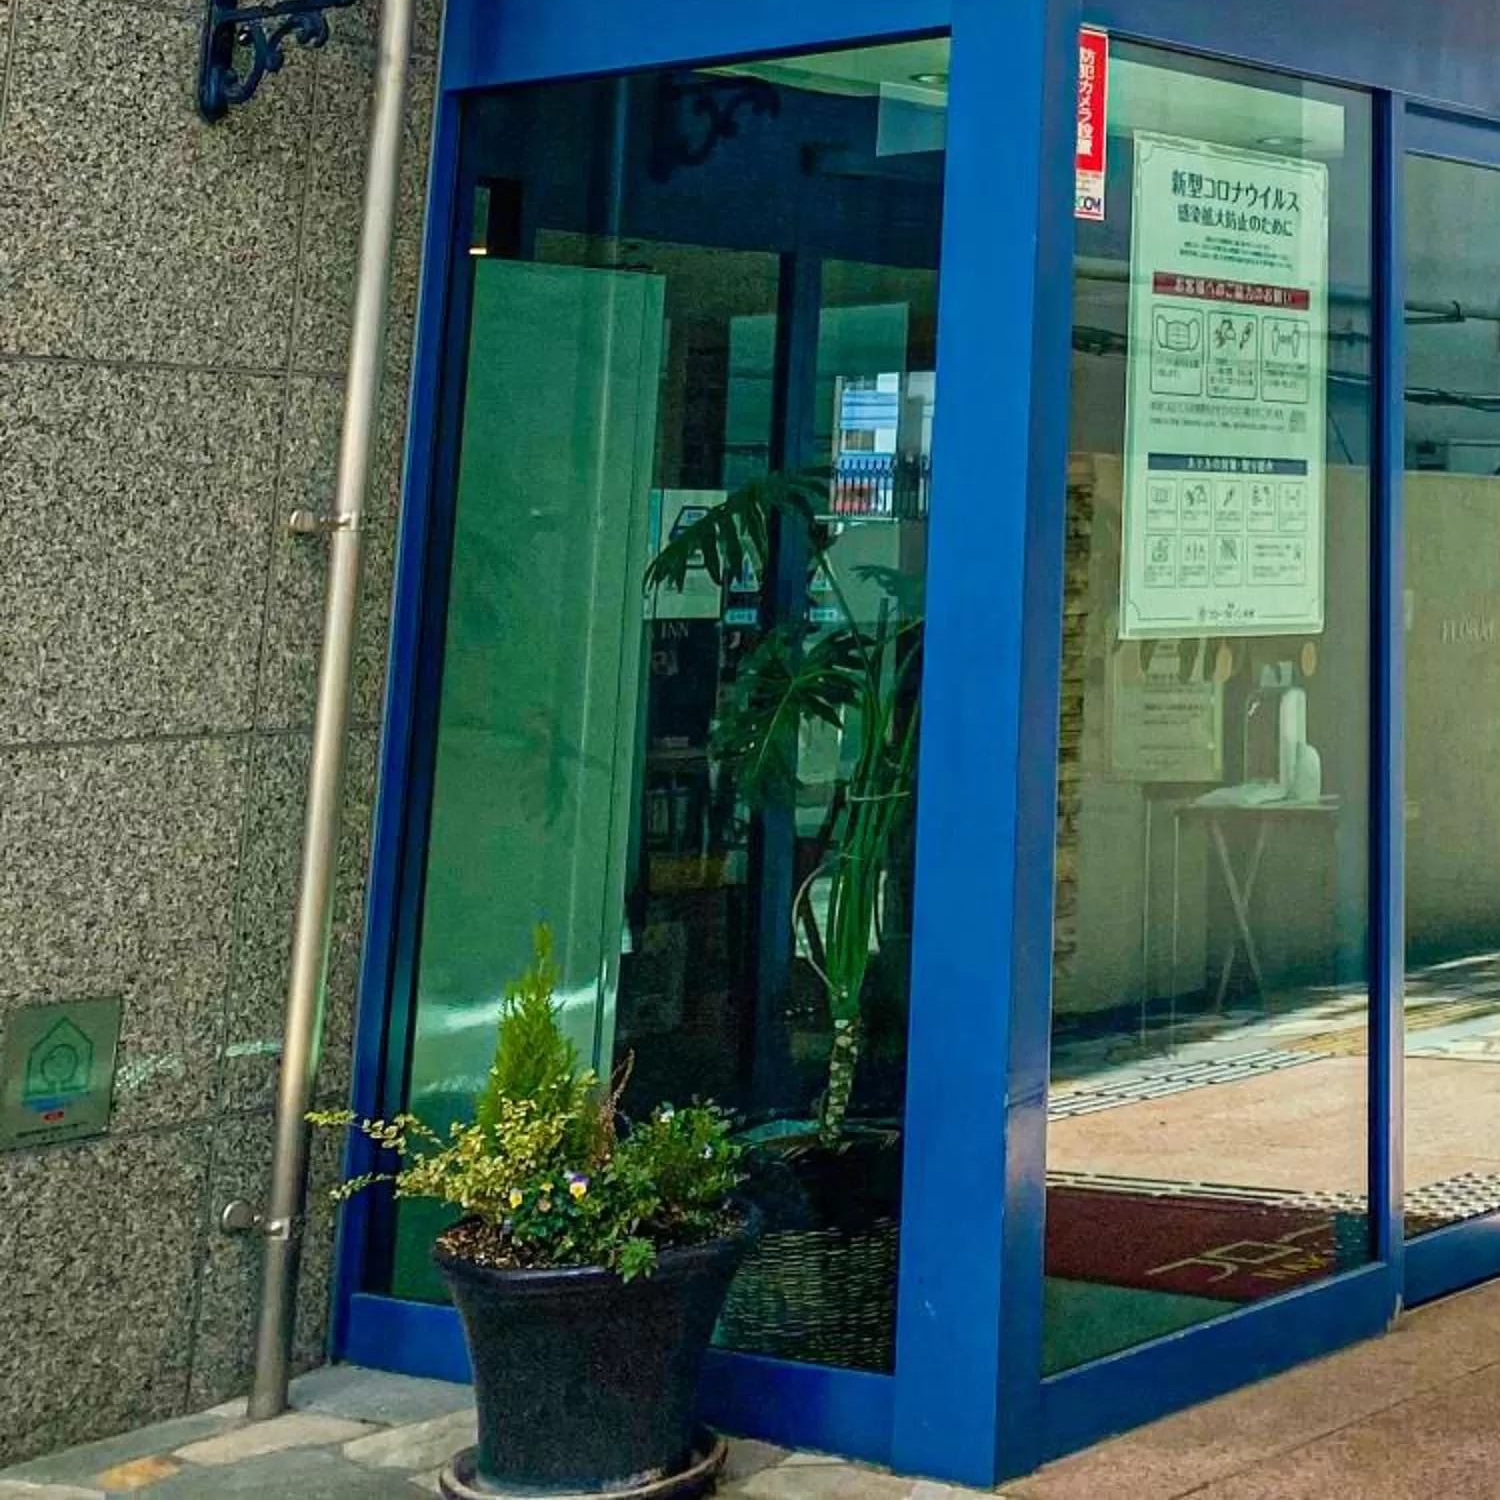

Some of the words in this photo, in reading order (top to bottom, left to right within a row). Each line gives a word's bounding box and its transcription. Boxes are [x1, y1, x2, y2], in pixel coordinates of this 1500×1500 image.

[1172, 169, 1300, 213] 新型コロナウイルス
[1177, 203, 1294, 238] 感染拡大防止のために
